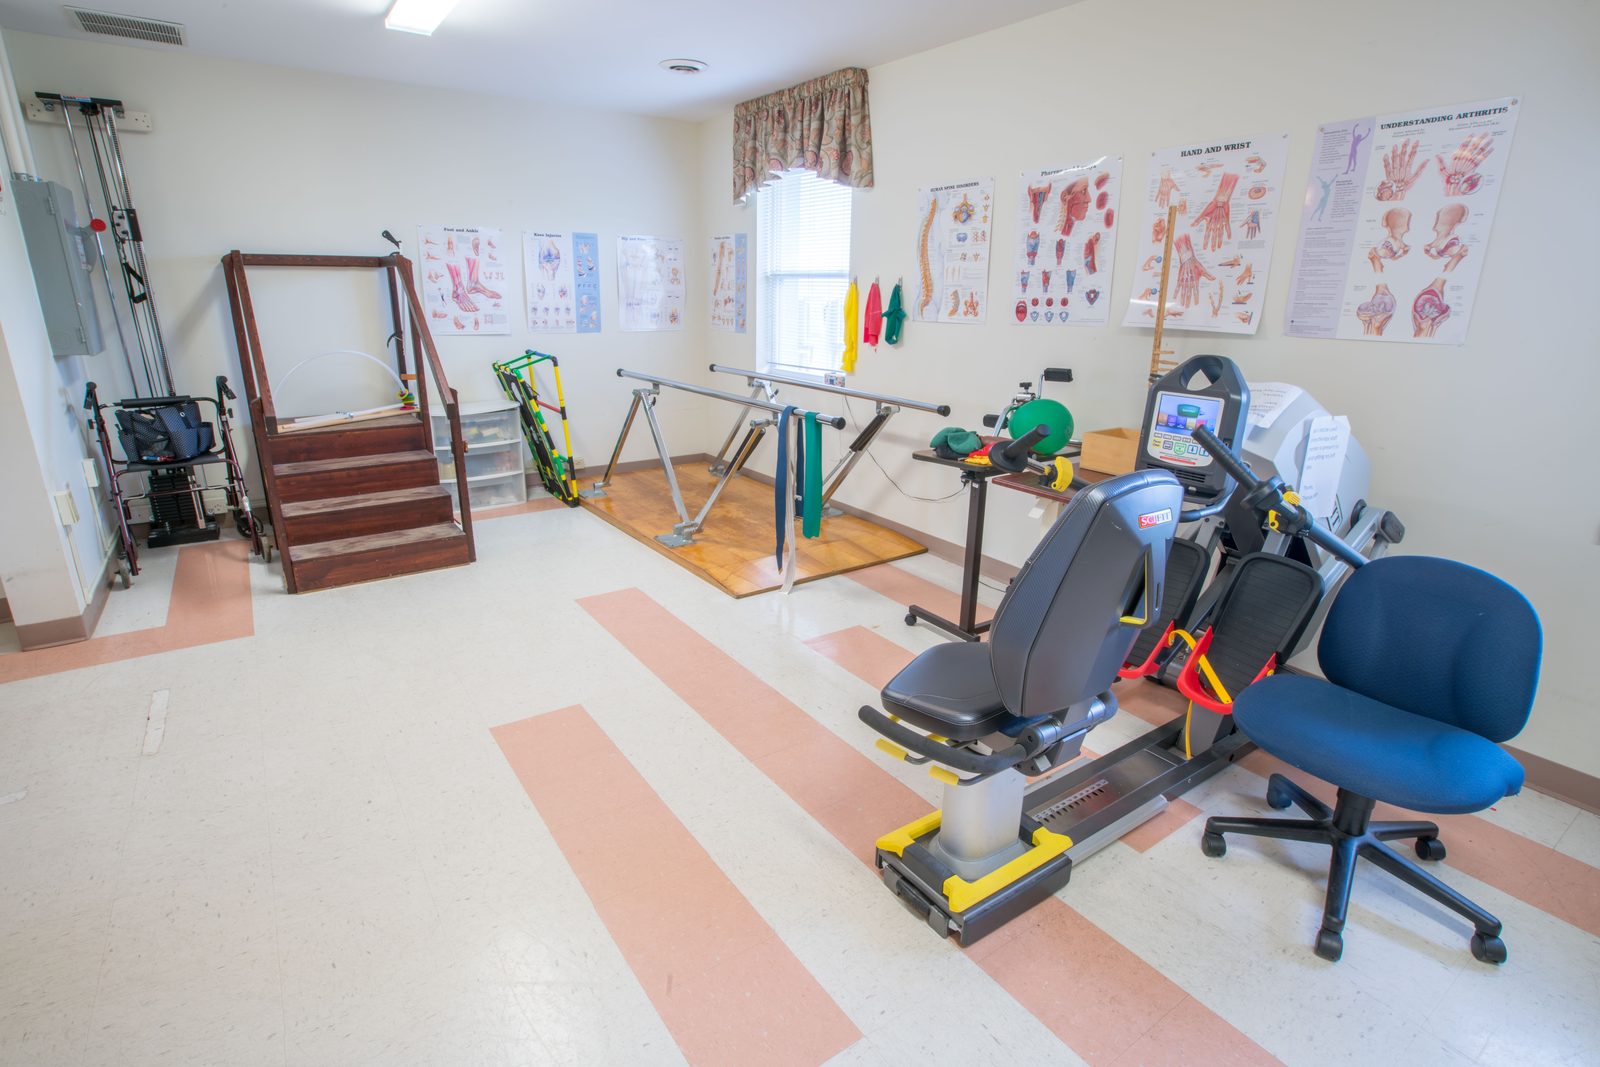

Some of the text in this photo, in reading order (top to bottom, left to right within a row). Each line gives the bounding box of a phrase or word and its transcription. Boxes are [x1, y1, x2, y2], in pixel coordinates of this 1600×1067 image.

[1380, 114, 1453, 130] UNDERSTANDING
[1455, 106, 1509, 120] ARTHRITIS
[1180, 141, 1252, 158] HAND AND WRIST
